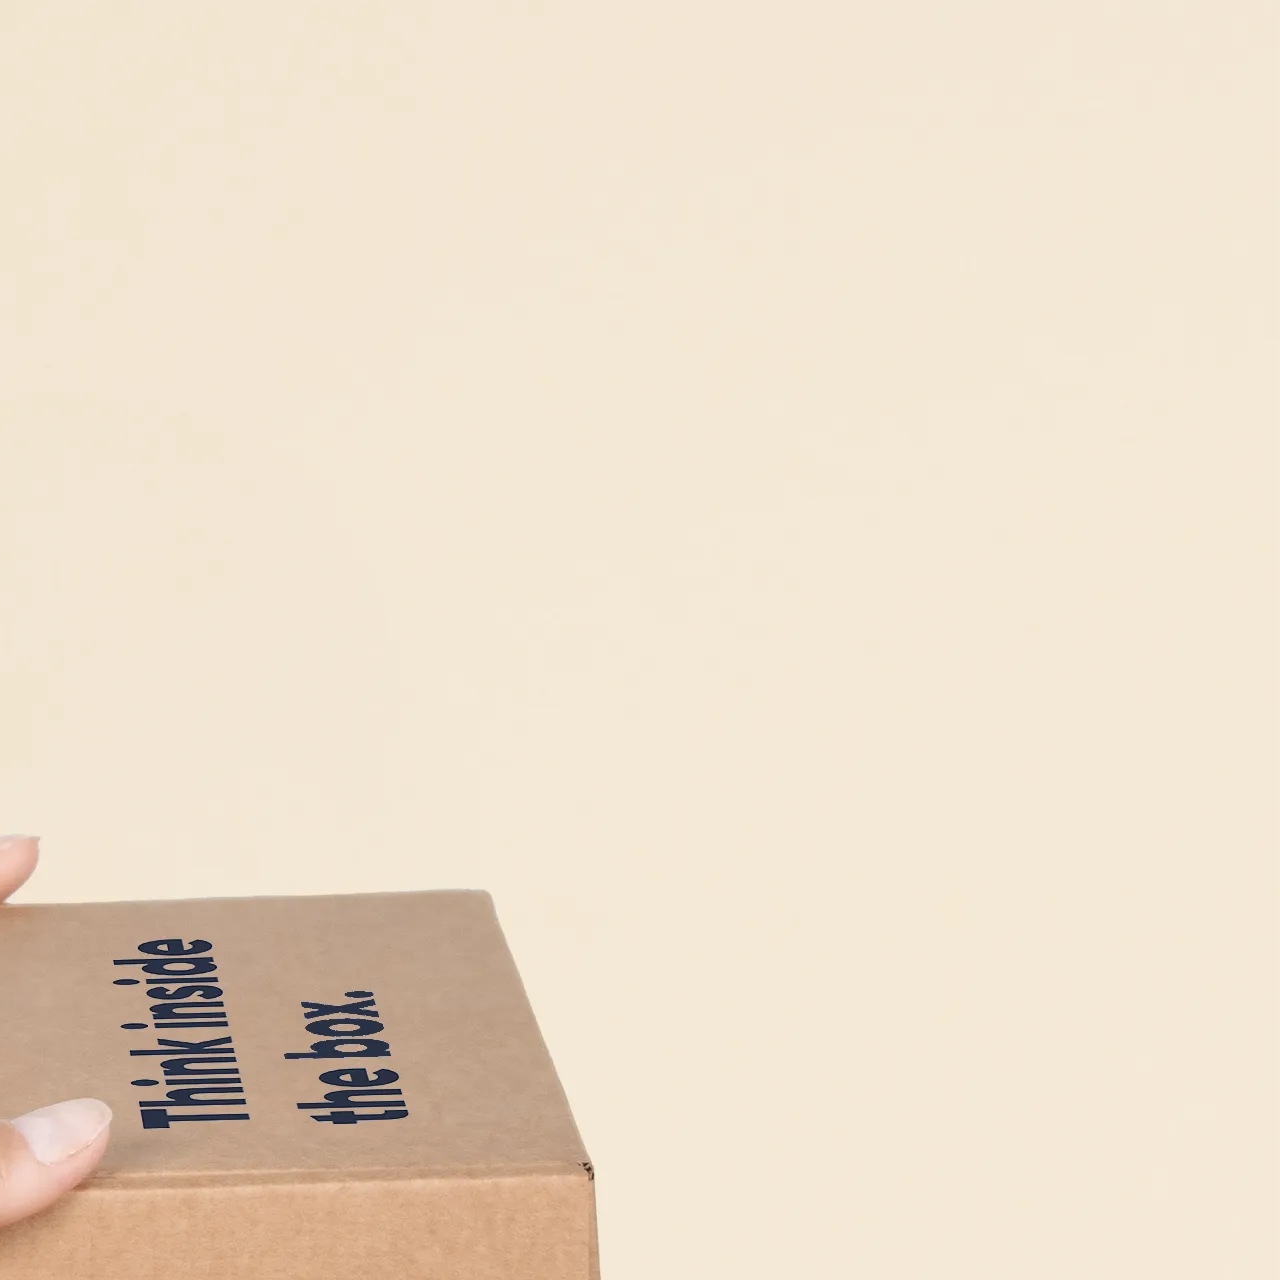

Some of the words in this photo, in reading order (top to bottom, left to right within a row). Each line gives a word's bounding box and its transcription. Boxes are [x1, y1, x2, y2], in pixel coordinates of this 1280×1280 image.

[113, 938, 229, 1029] inside
[284, 990, 392, 1060] box.
[130, 1036, 251, 1129] Think
[296, 1067, 409, 1125] the
